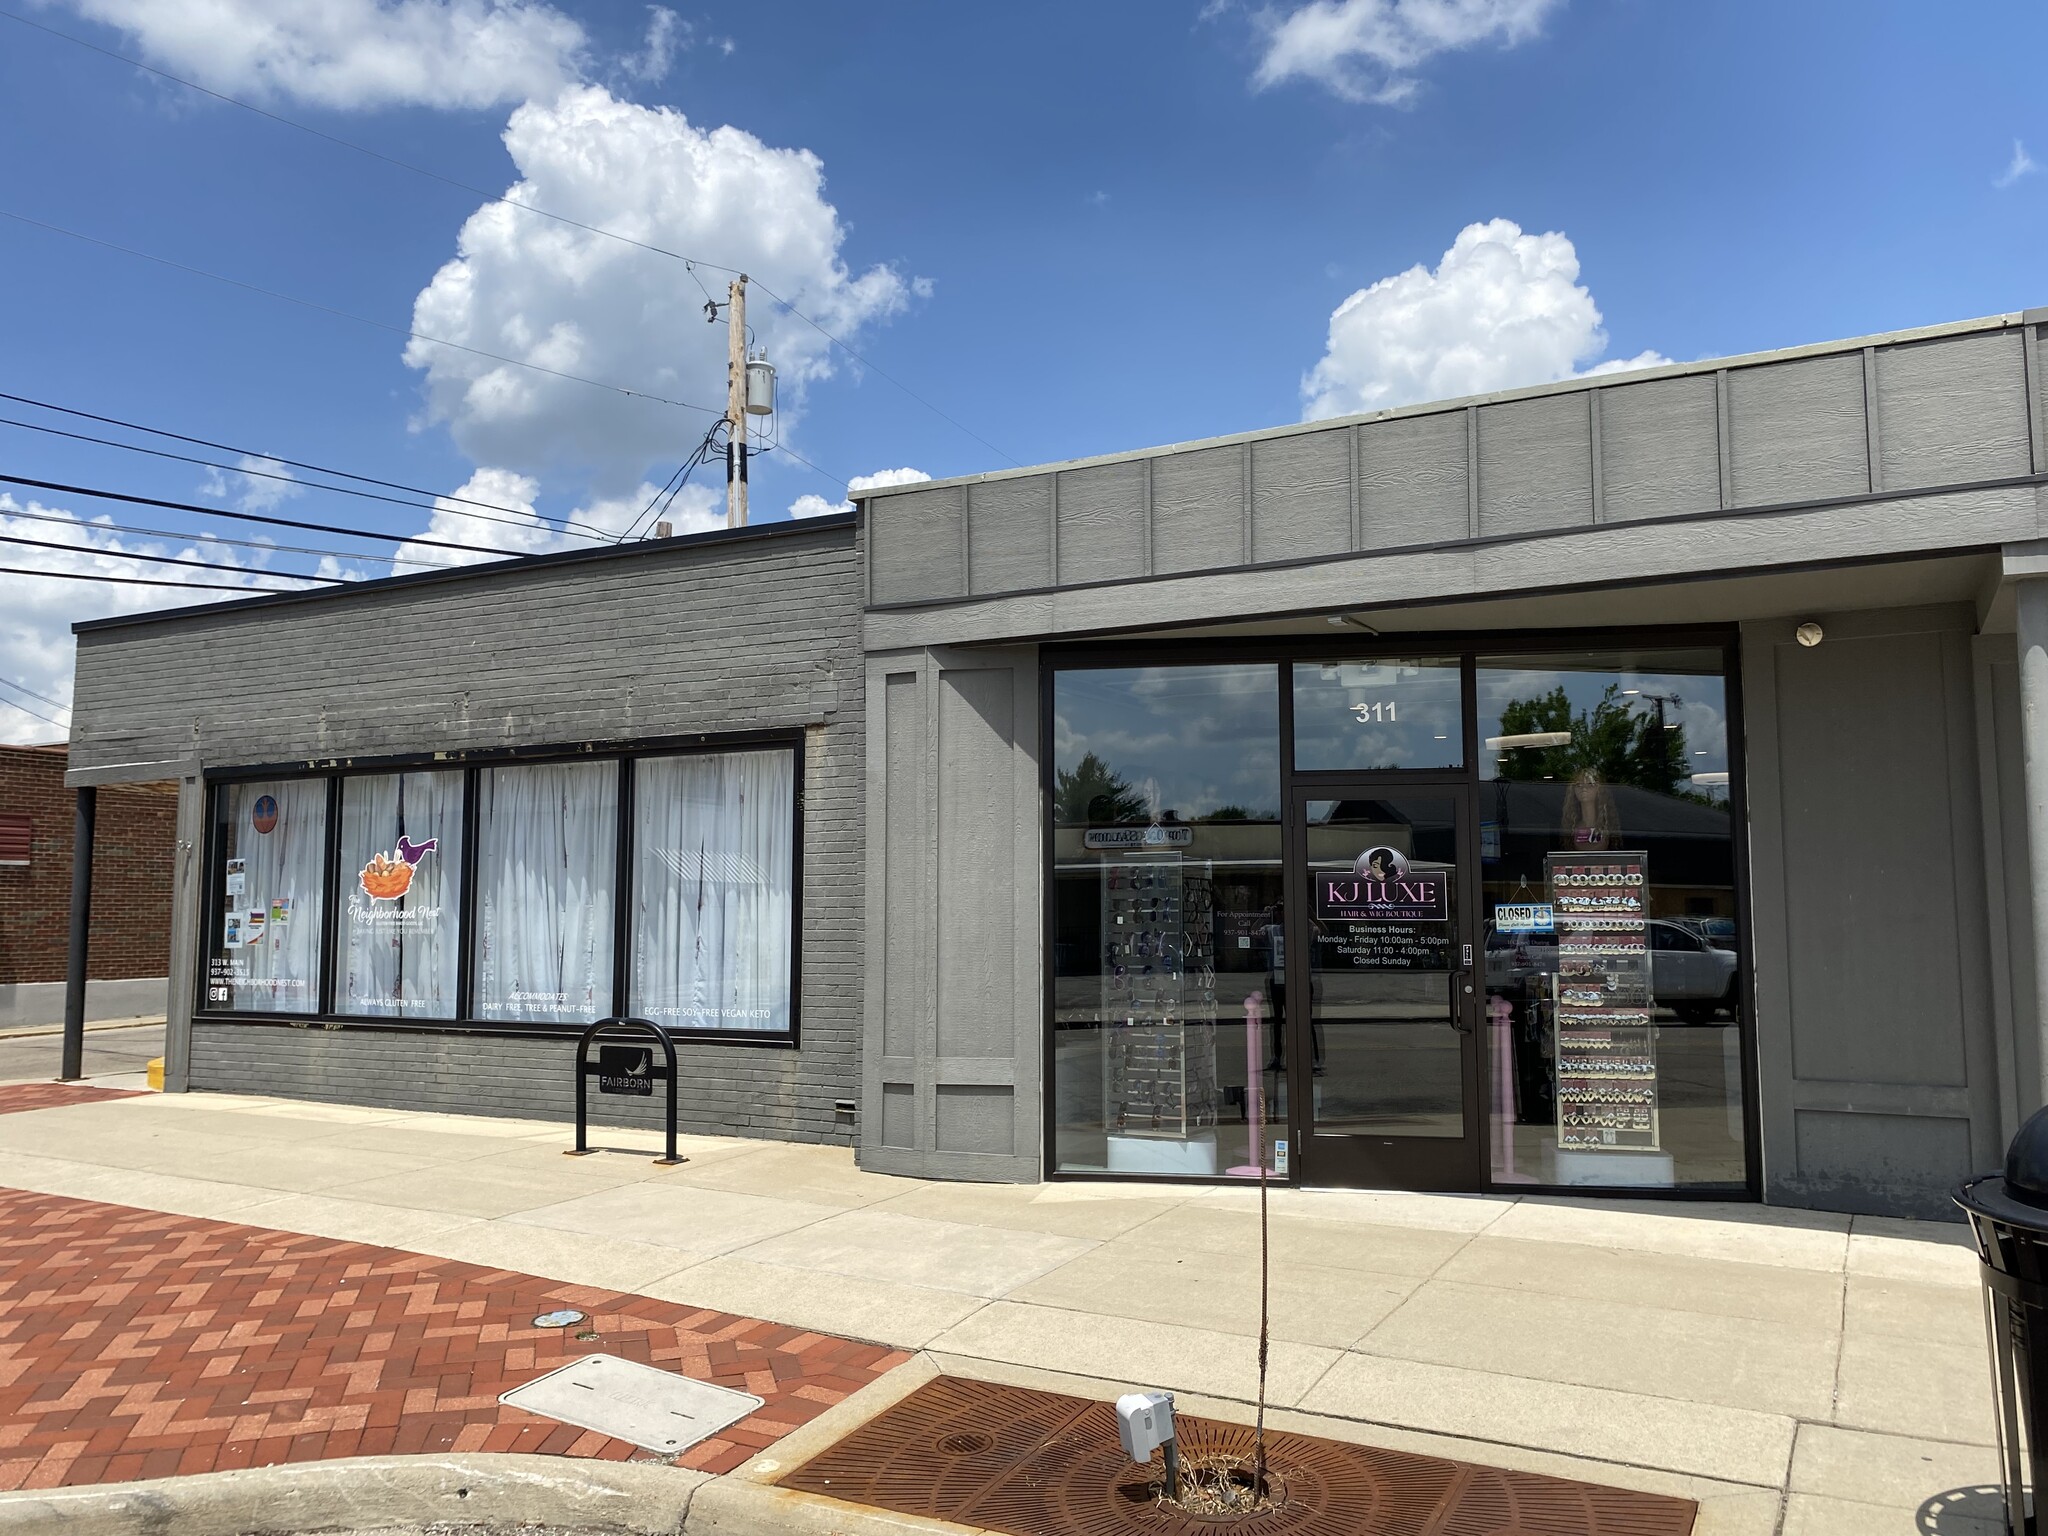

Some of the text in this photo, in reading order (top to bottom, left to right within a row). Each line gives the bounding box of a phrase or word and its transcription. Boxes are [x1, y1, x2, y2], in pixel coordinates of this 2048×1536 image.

[1356, 701, 1396, 723] 311
[1327, 882, 1436, 903] KJ LUXE
[347, 904, 442, 926] Neighborhood Nest
[1216, 910, 1271, 919] For Appointment
[1340, 910, 1424, 918] HAIR & WIG BOUTIQUE
[1497, 907, 1531, 921] CLOSED
[1349, 925, 1416, 934] Business Hours:
[1317, 935, 1347, 945] Monday
[1354, 935, 1378, 945] Friday
[1380, 936, 1413, 944] 10:00am
[1420, 936, 1450, 946] 5:00pm
[1336, 945, 1371, 955] Saturday
[1373, 946, 1394, 954] 11:00
[1400, 947, 1430, 956] 4:00pm
[210, 958, 222, 967] 313
[222, 959, 229, 967] W.
[1353, 956, 1411, 967] Closed Sunday
[360, 998, 426, 1008] ALWAYS GLUTEN FREE
[482, 1002, 502, 1011] DAIRY
[524, 1003, 541, 1012] TREE
[542, 1004, 548, 1012] &
[549, 1004, 596, 1014] PEANUT-FREE
[644, 1006, 681, 1016] EGG-FREE
[721, 1008, 747, 1018] VEGAN
[749, 1009, 771, 1019] KETO
[601, 1076, 651, 1089] FAIRBORN
